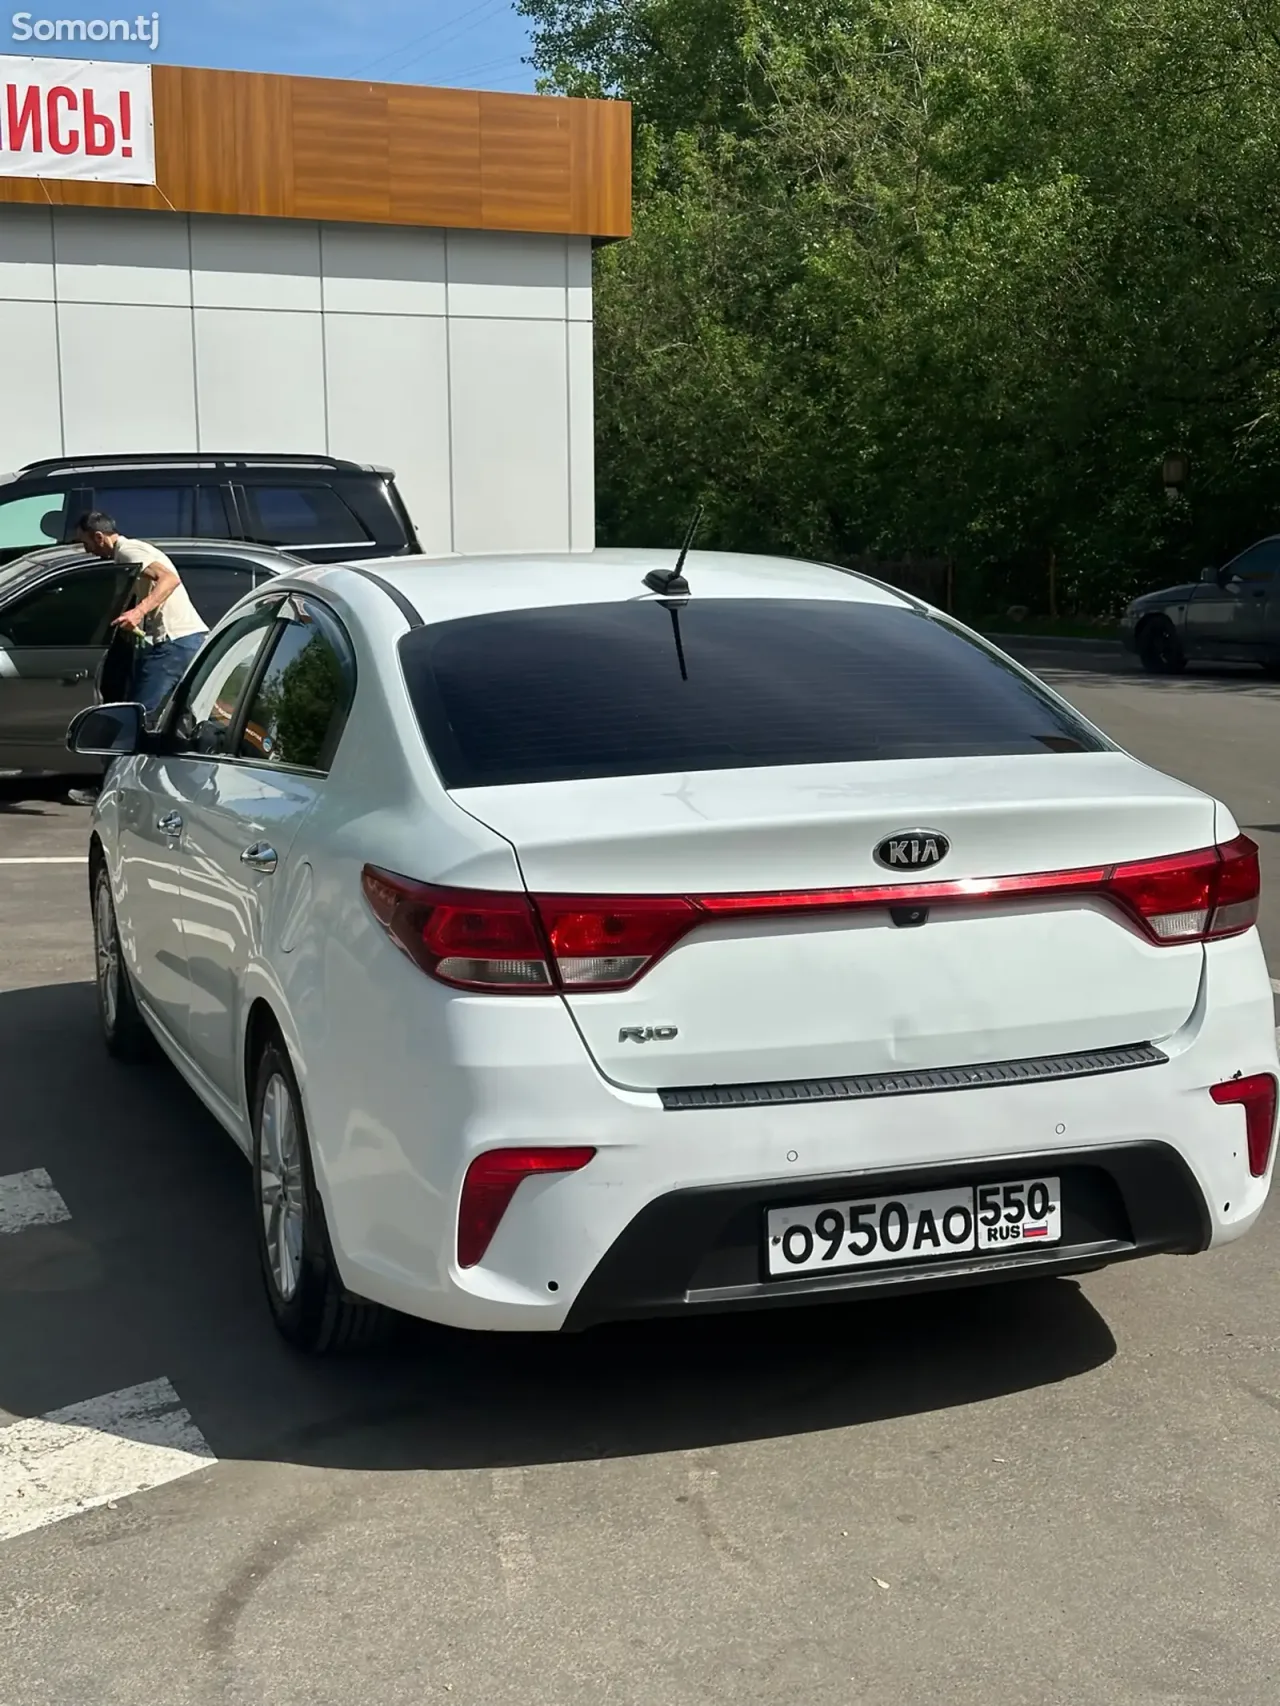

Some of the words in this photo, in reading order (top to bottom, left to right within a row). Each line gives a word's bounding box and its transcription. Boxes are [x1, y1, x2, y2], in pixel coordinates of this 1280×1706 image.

[0, 83, 133, 158] ИСЬ!
[889, 839, 940, 863] KIA
[618, 1025, 678, 1044] RIO
[979, 1182, 1049, 1226] 550
[987, 1225, 1020, 1241] RUS
